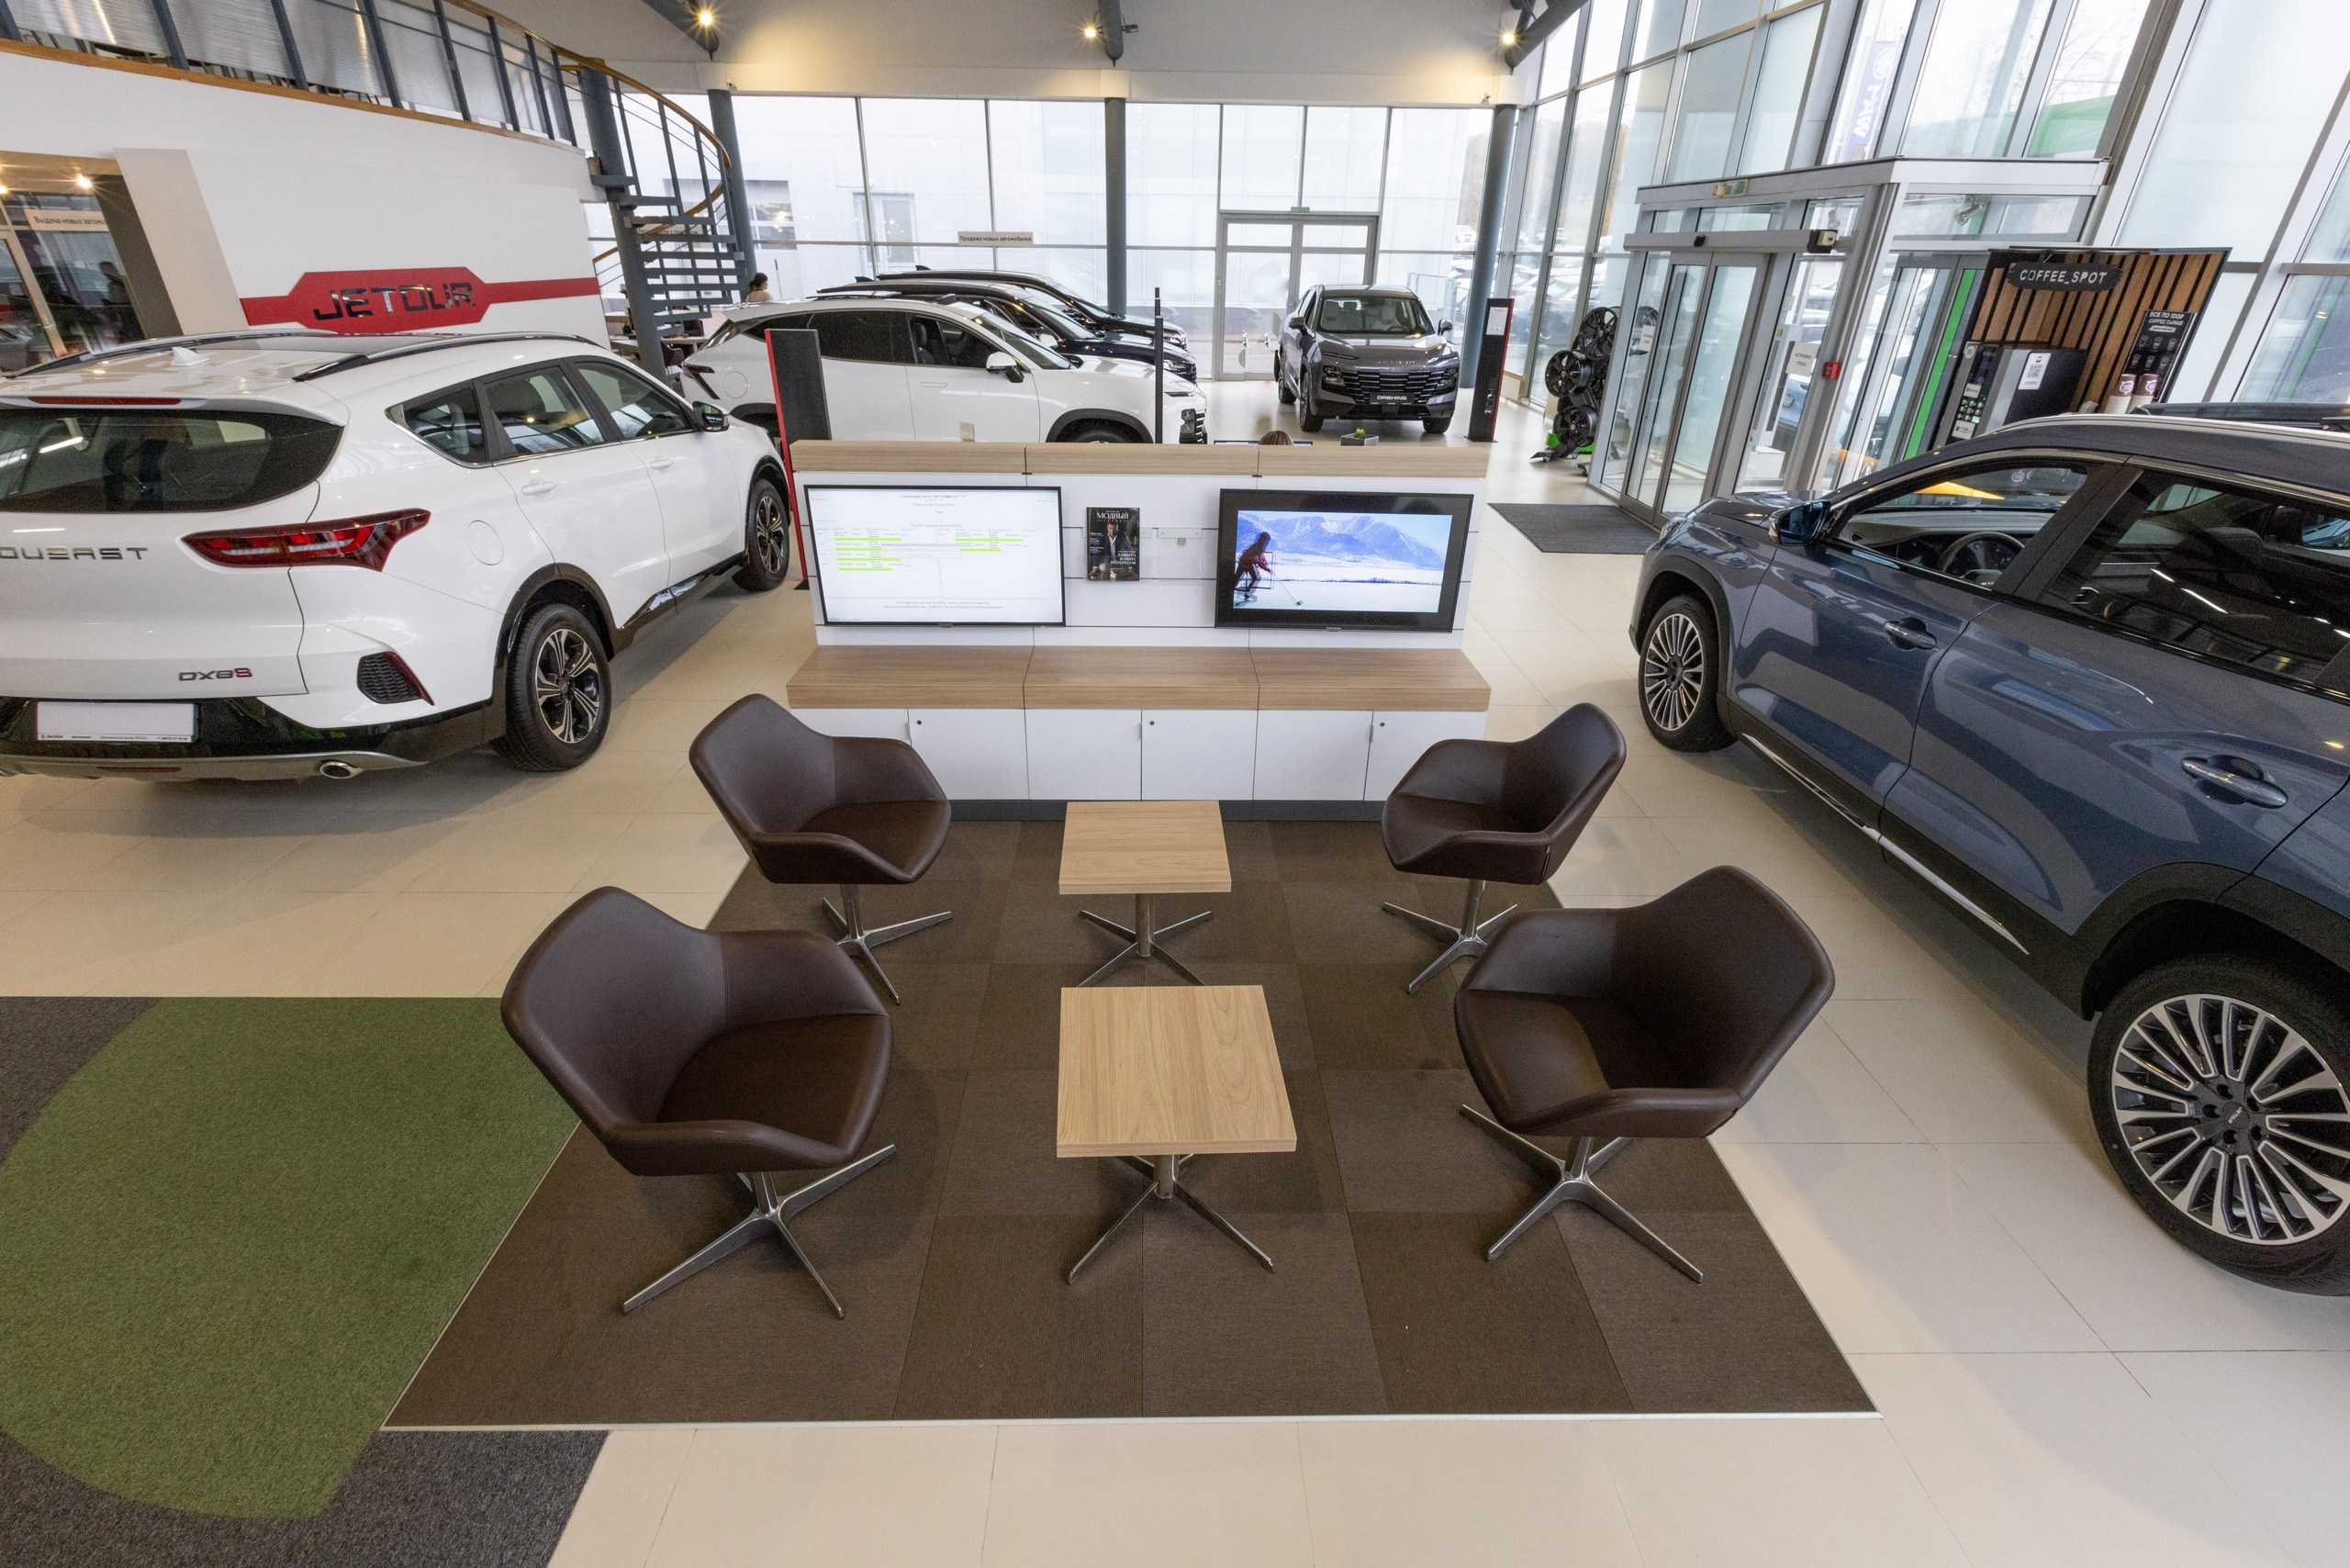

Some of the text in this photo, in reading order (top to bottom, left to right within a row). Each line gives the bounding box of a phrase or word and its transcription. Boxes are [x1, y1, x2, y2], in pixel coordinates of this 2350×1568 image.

[313, 282, 477, 321] JETOUR
[1097, 511, 1129, 520] МОДНЫЙ
[179, 667, 252, 681] DX8S
